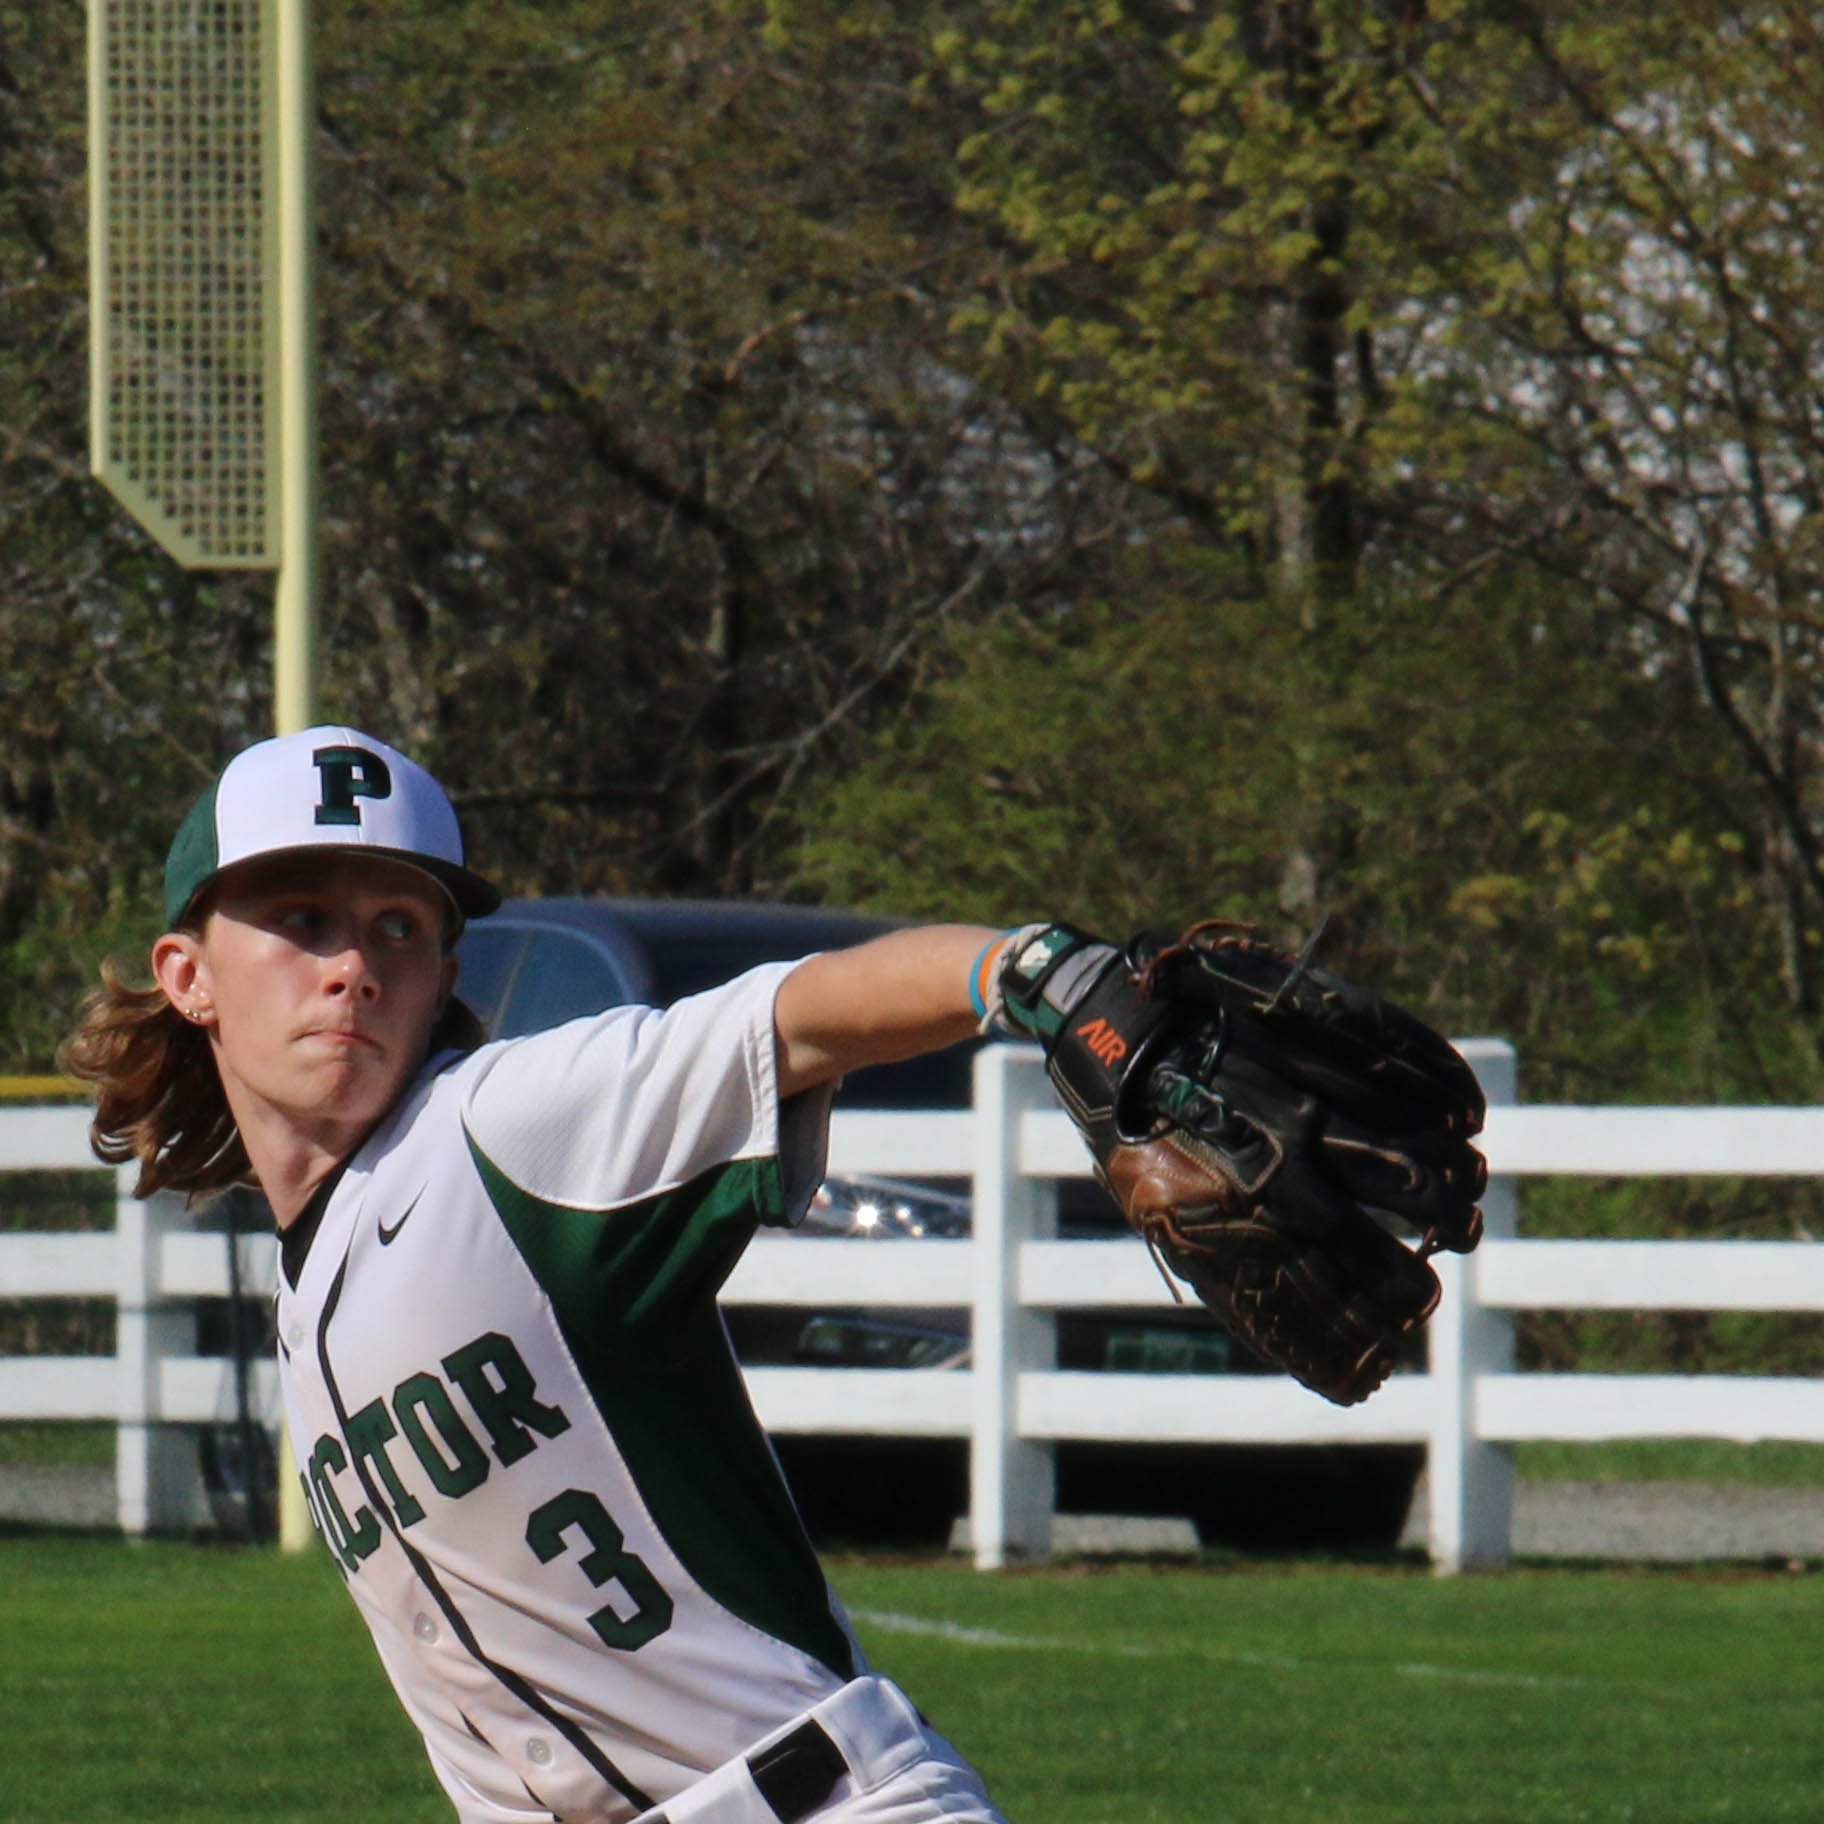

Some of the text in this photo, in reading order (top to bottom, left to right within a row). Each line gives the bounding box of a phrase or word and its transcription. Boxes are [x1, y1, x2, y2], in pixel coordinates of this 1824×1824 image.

[313, 745, 392, 826] P
[299, 1331, 572, 1582] OCTOR
[525, 1488, 675, 1652] 3
